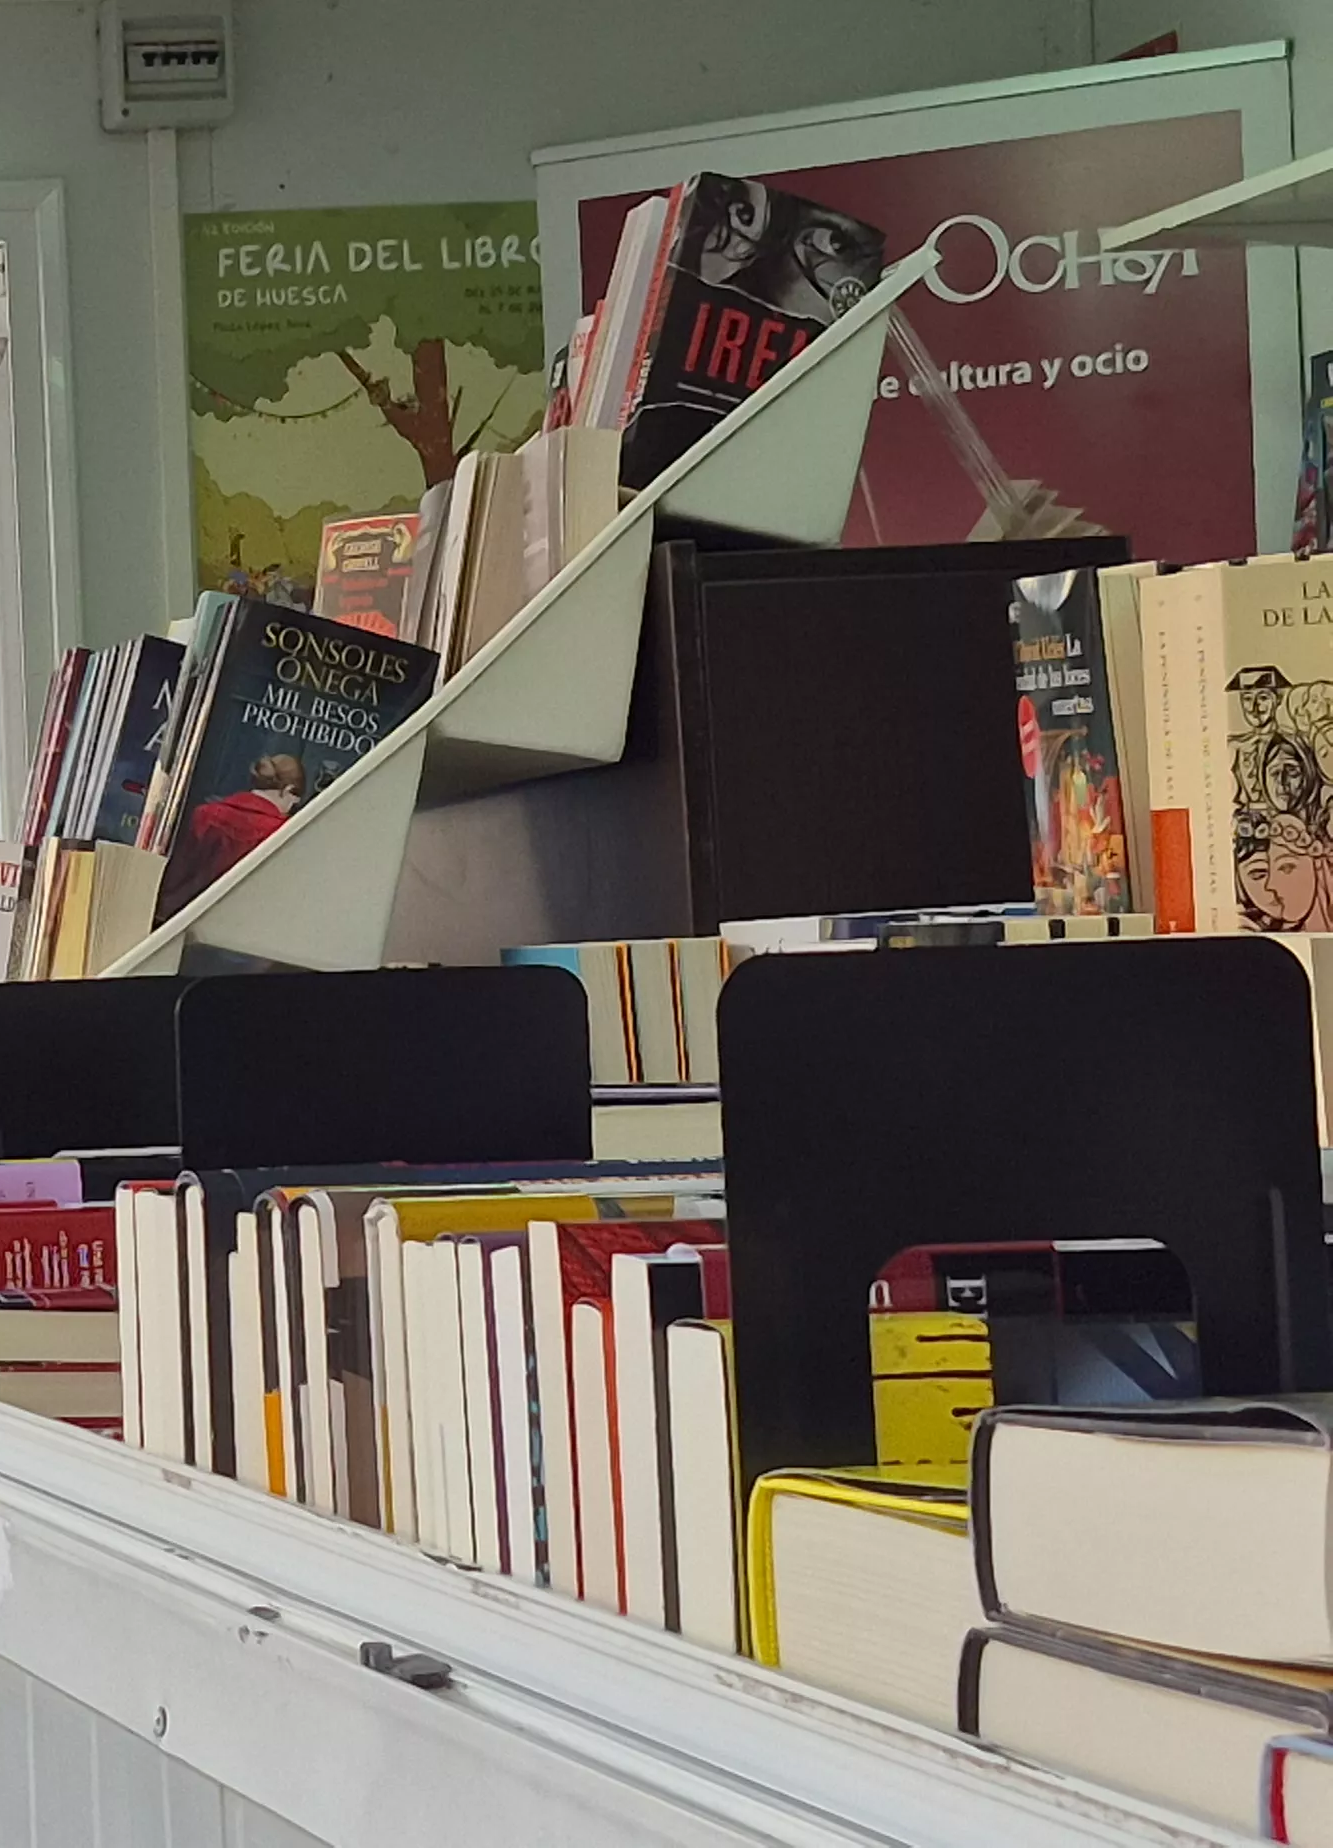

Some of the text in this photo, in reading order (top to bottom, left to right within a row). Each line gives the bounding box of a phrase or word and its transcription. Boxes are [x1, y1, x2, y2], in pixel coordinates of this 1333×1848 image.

[218, 240, 331, 278] FERIA
[348, 239, 423, 272] DEL
[217, 283, 348, 308] DE HUESCA
[684, 302, 808, 389] IRE
[874, 342, 1150, 400] e cltura y ocio
[1263, 607, 1294, 627] DE
[262, 622, 409, 684] SONSOLES
[276, 656, 379, 706] ONEGA
[242, 703, 379, 754] PROHIBIDO
[262, 683, 380, 735] MIL BESOS
